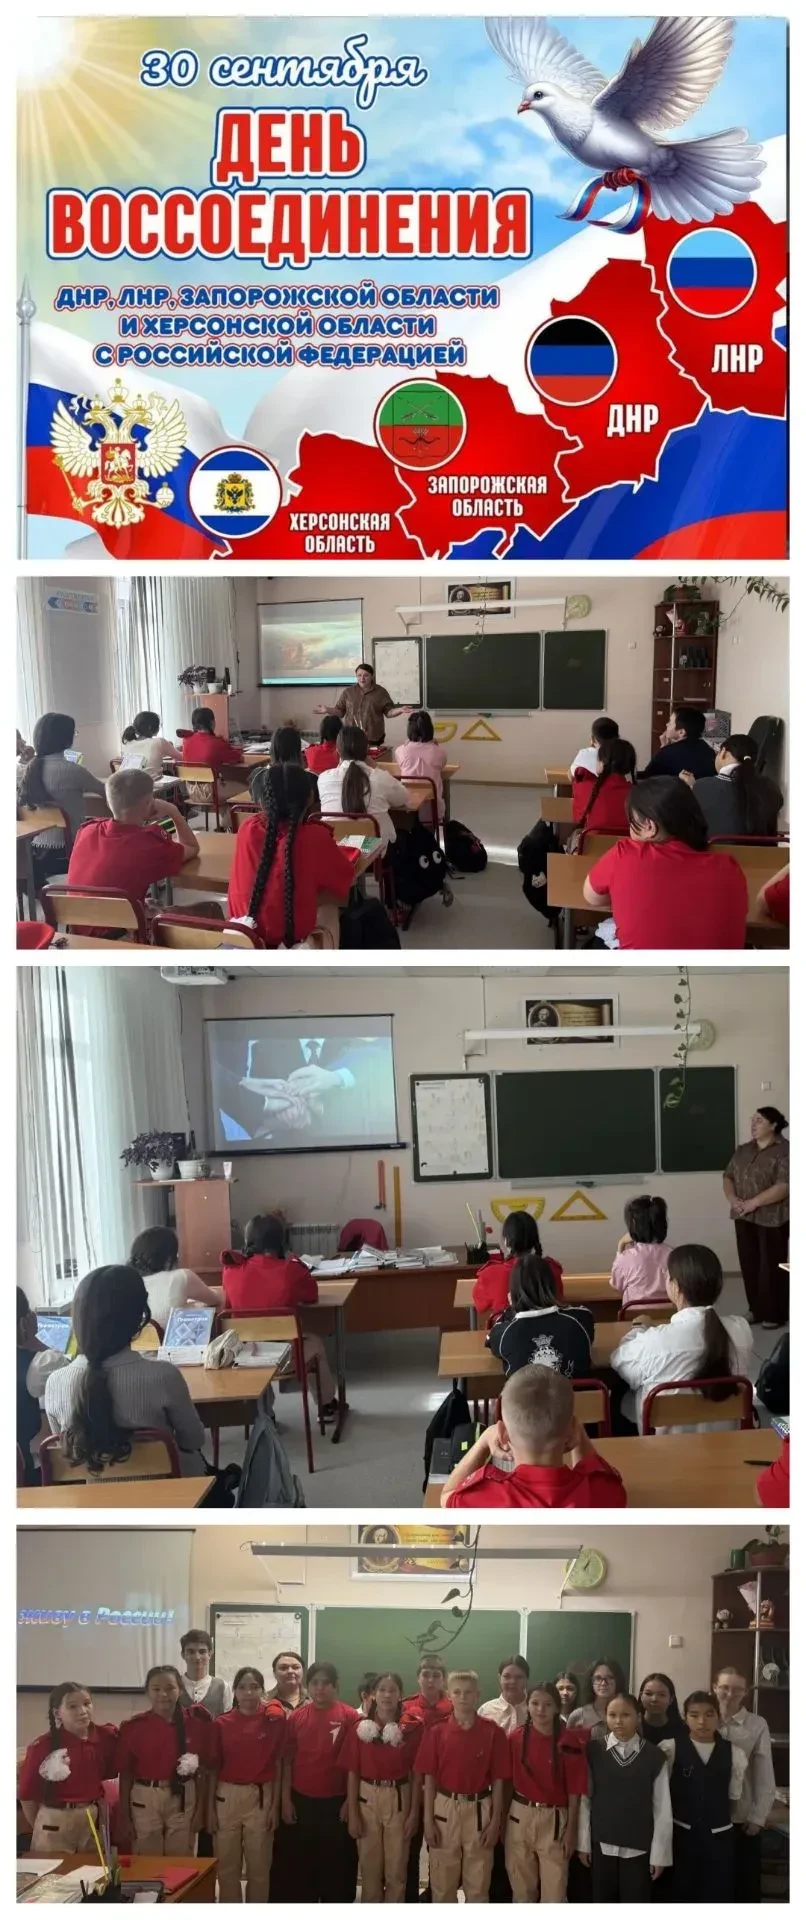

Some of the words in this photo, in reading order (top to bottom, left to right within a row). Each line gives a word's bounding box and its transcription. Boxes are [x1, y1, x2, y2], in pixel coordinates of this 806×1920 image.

[141, 50, 198, 85] 30
[210, 34, 427, 108] сентября
[215, 112, 362, 183] ДЕНЬ
[50, 193, 531, 264] ВОССОЕДИНЕНИЯ
[56, 287, 115, 308] ДНР,
[119, 287, 175, 308] ЛНР,
[180, 281, 375, 308] ЗАПОРОЖСКОЙ
[381, 287, 499, 307] ОБЛАСТИ
[121, 315, 137, 335] И
[142, 310, 312, 336] ХЕРСОНСКОЙ
[318, 315, 435, 336] ОБЛАСТИ
[95, 344, 112, 365] С
[118, 338, 293, 365] РОССИЙСКОЙ
[298, 338, 465, 368] ФЕДЕРАЦИЕЙ
[711, 343, 764, 374] ЛНР
[606, 403, 660, 438] ДНР
[427, 475, 548, 495] ЗАПОРОЖСКАЯ
[289, 512, 391, 531] ХЕРСОНСКАЯ
[451, 498, 524, 518] ОБЛАСТЬ
[304, 535, 375, 553] ОБЛАСТЬ
[95, 1606, 175, 1627] России!
